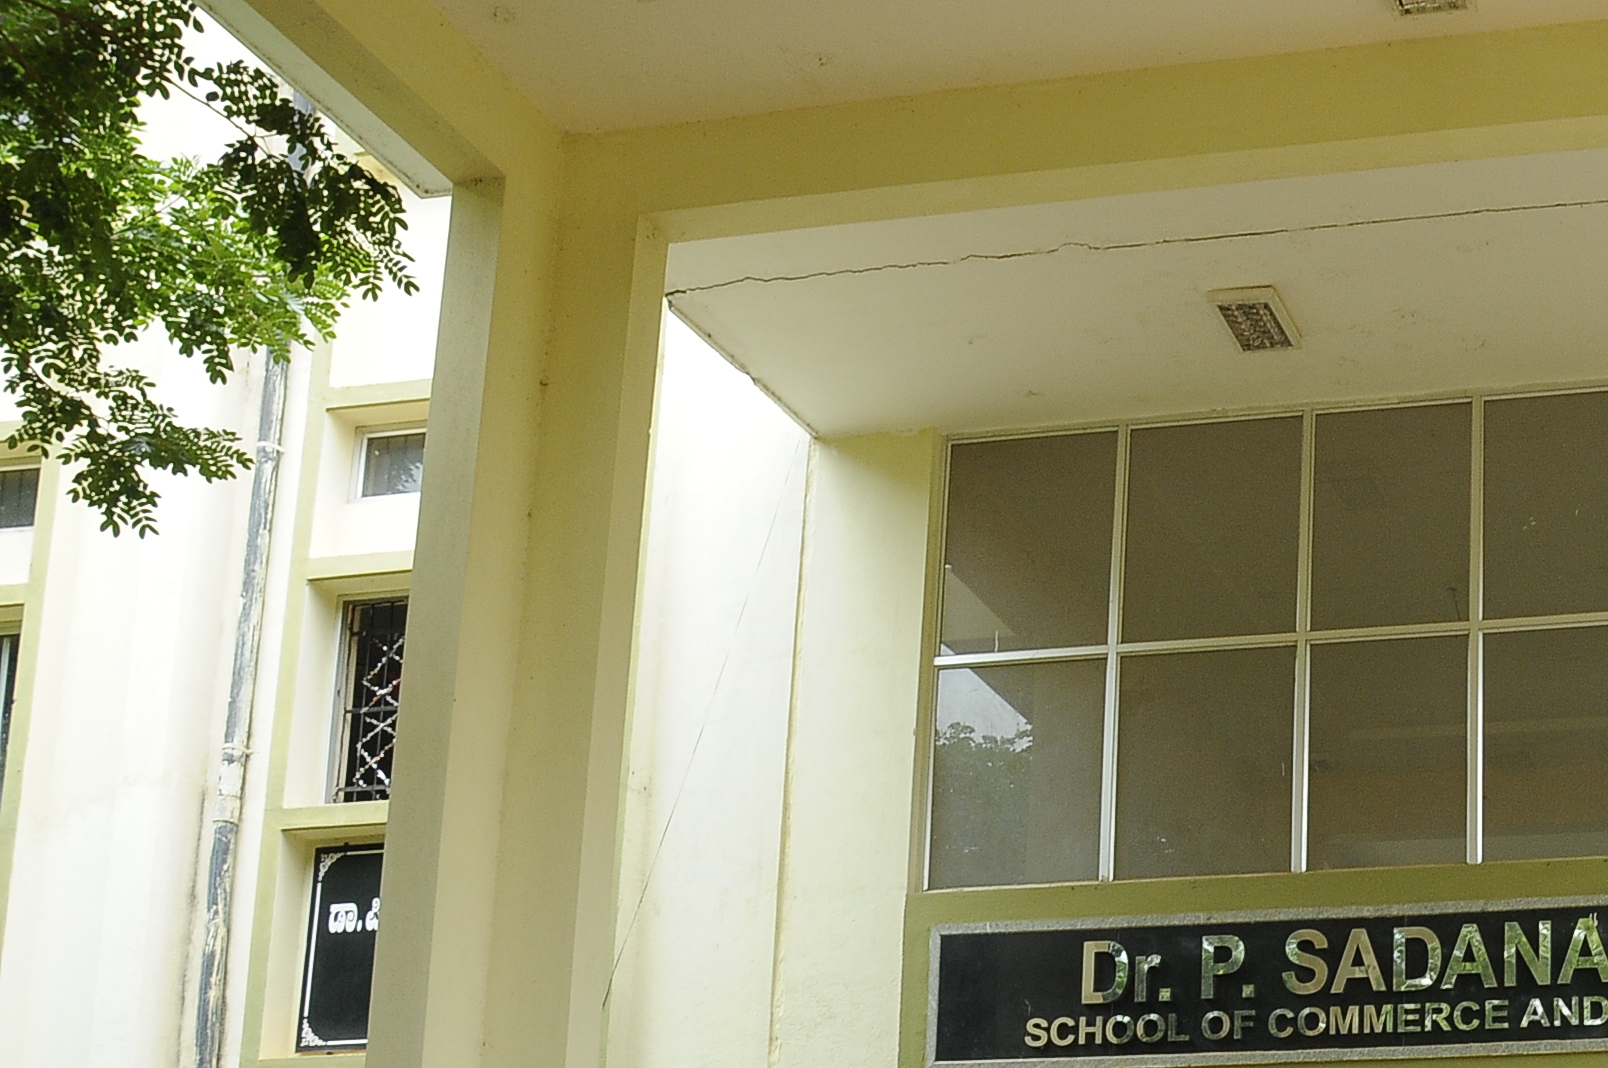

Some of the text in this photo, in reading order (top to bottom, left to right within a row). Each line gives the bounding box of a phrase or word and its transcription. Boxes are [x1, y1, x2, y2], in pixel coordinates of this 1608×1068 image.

[1080, 940, 1172, 1005] Dr.
[1200, 934, 1255, 1000] P.
[1023, 1013, 1190, 1049] SCHOOL
[1201, 1010, 1256, 1040] OF
[1267, 999, 1510, 1039] COMMERCE
